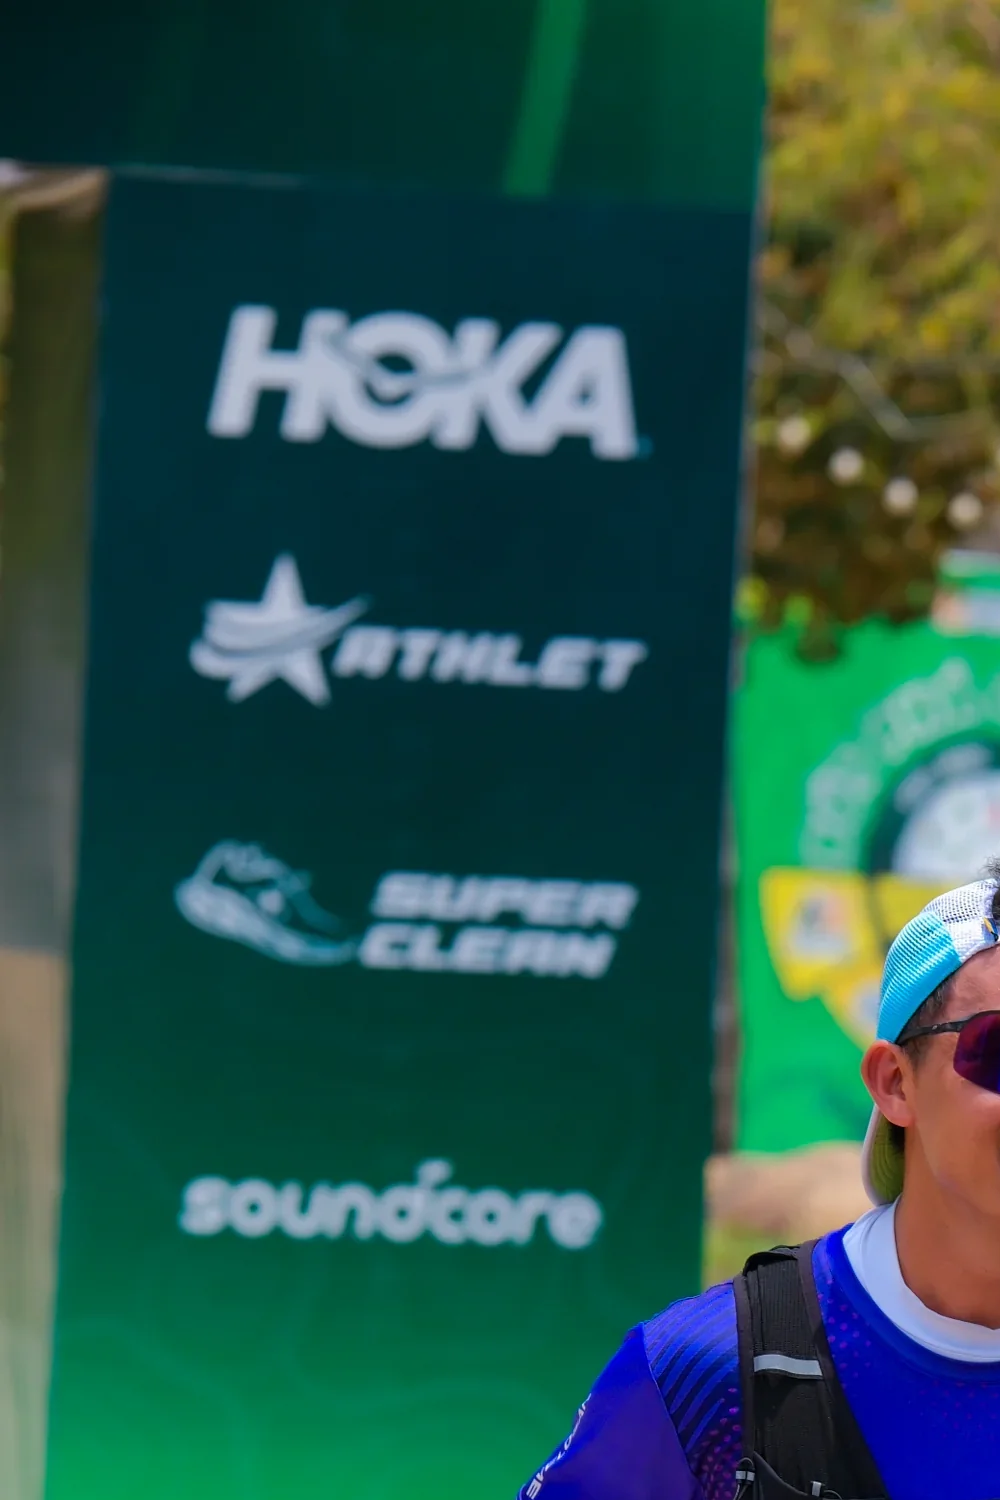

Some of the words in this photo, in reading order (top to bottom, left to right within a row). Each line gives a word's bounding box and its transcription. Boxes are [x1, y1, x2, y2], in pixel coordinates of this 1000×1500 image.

[206, 303, 639, 461] HOKA
[372, 871, 639, 930] SUPER
[357, 924, 617, 978] CLEAN
[178, 1158, 603, 1251] soundcore
